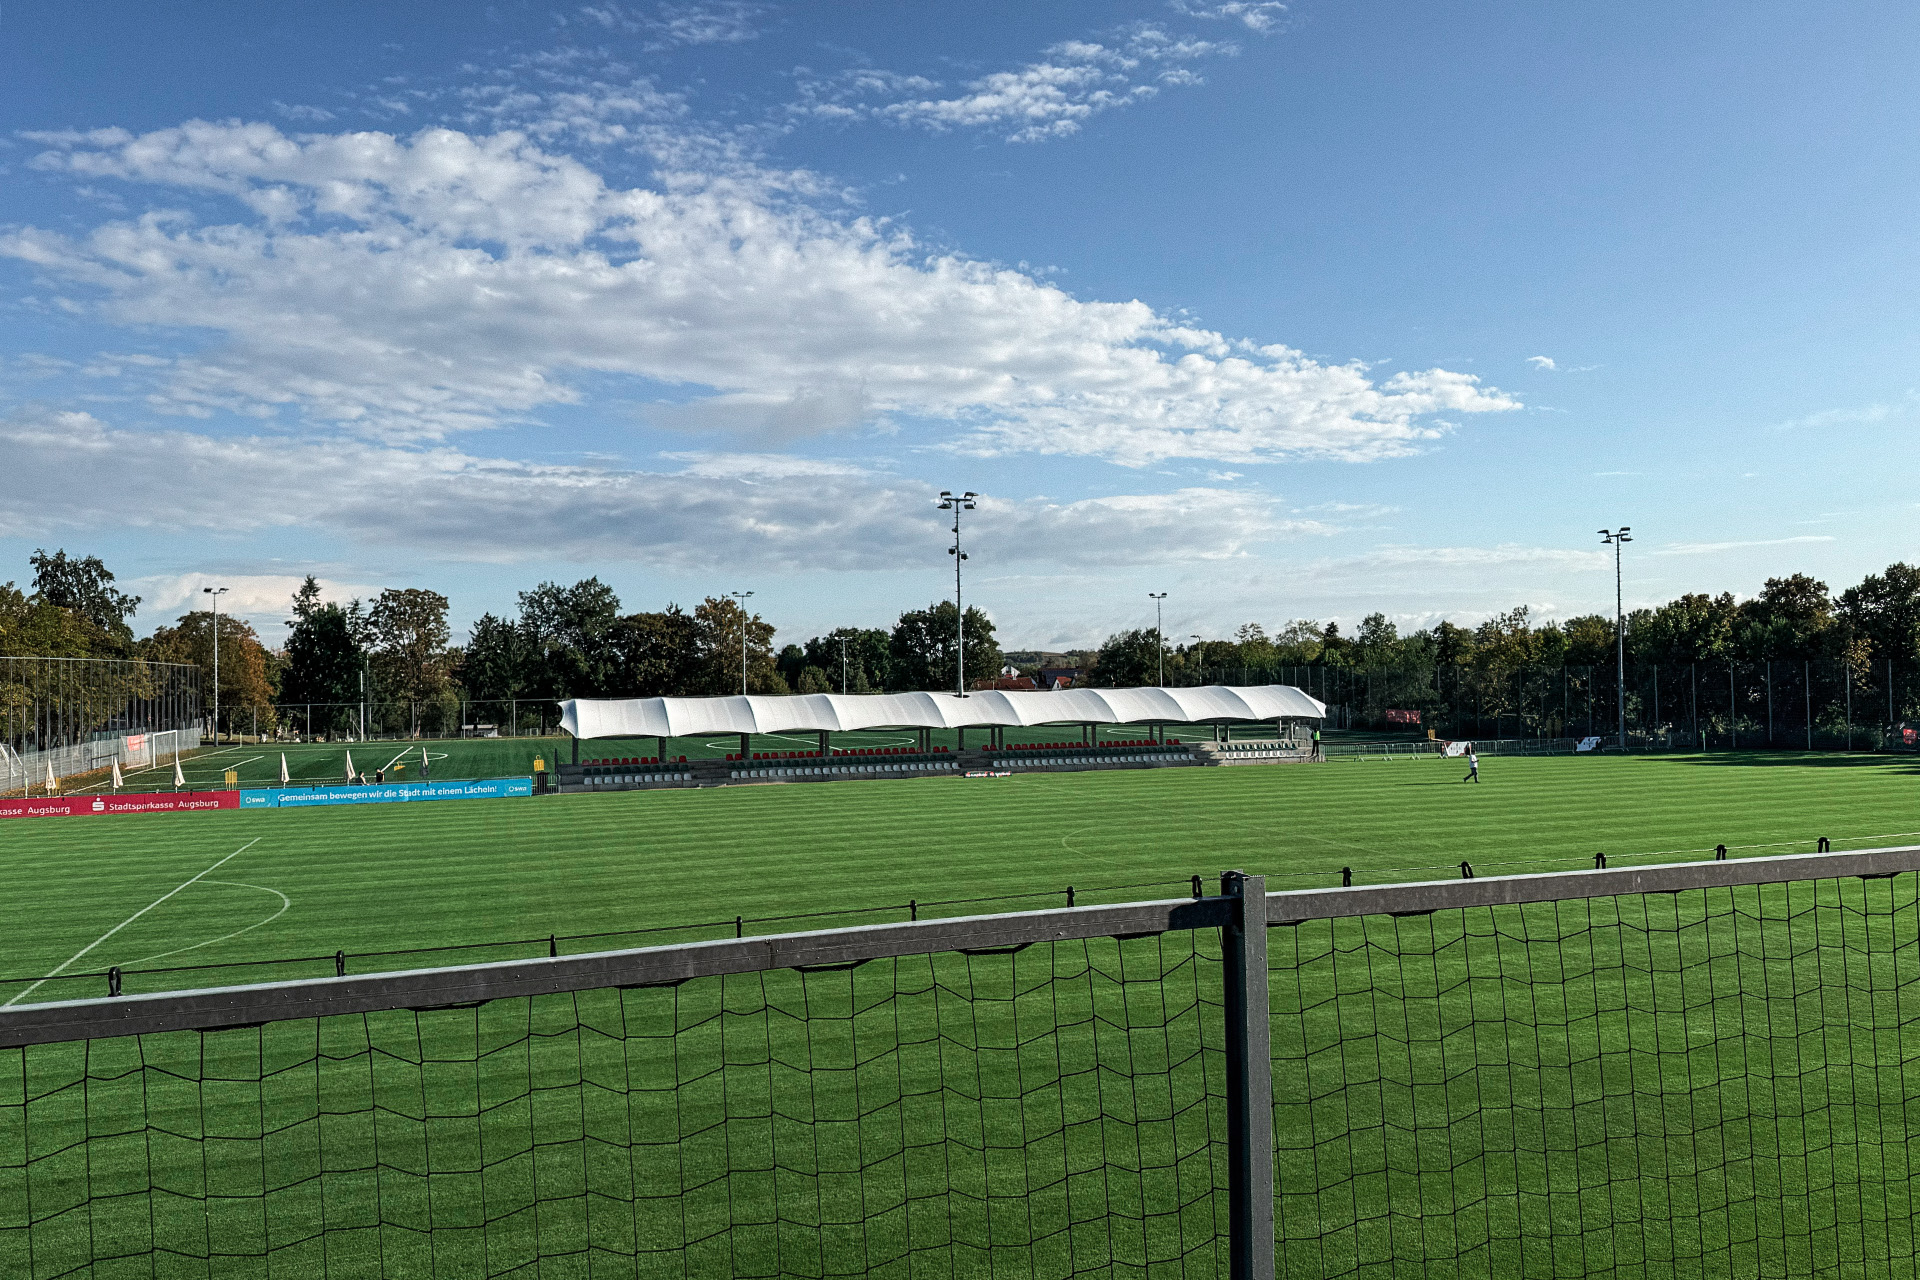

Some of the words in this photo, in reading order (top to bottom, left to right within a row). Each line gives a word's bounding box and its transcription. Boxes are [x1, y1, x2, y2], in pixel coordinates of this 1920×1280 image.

[278, 794, 327, 802] Gemeinsam
[329, 790, 368, 801] bewegen
[369, 790, 382, 798] wir
[384, 789, 397, 798] die
[398, 788, 420, 797] Stadt
[422, 787, 436, 796] mit
[438, 787, 463, 795] einem
[464, 785, 498, 794] Lächeln!
[27, 806, 70, 816] Augsburg
[109, 801, 174, 811] Stadtsparkasse
[178, 799, 220, 809] Augsburg
